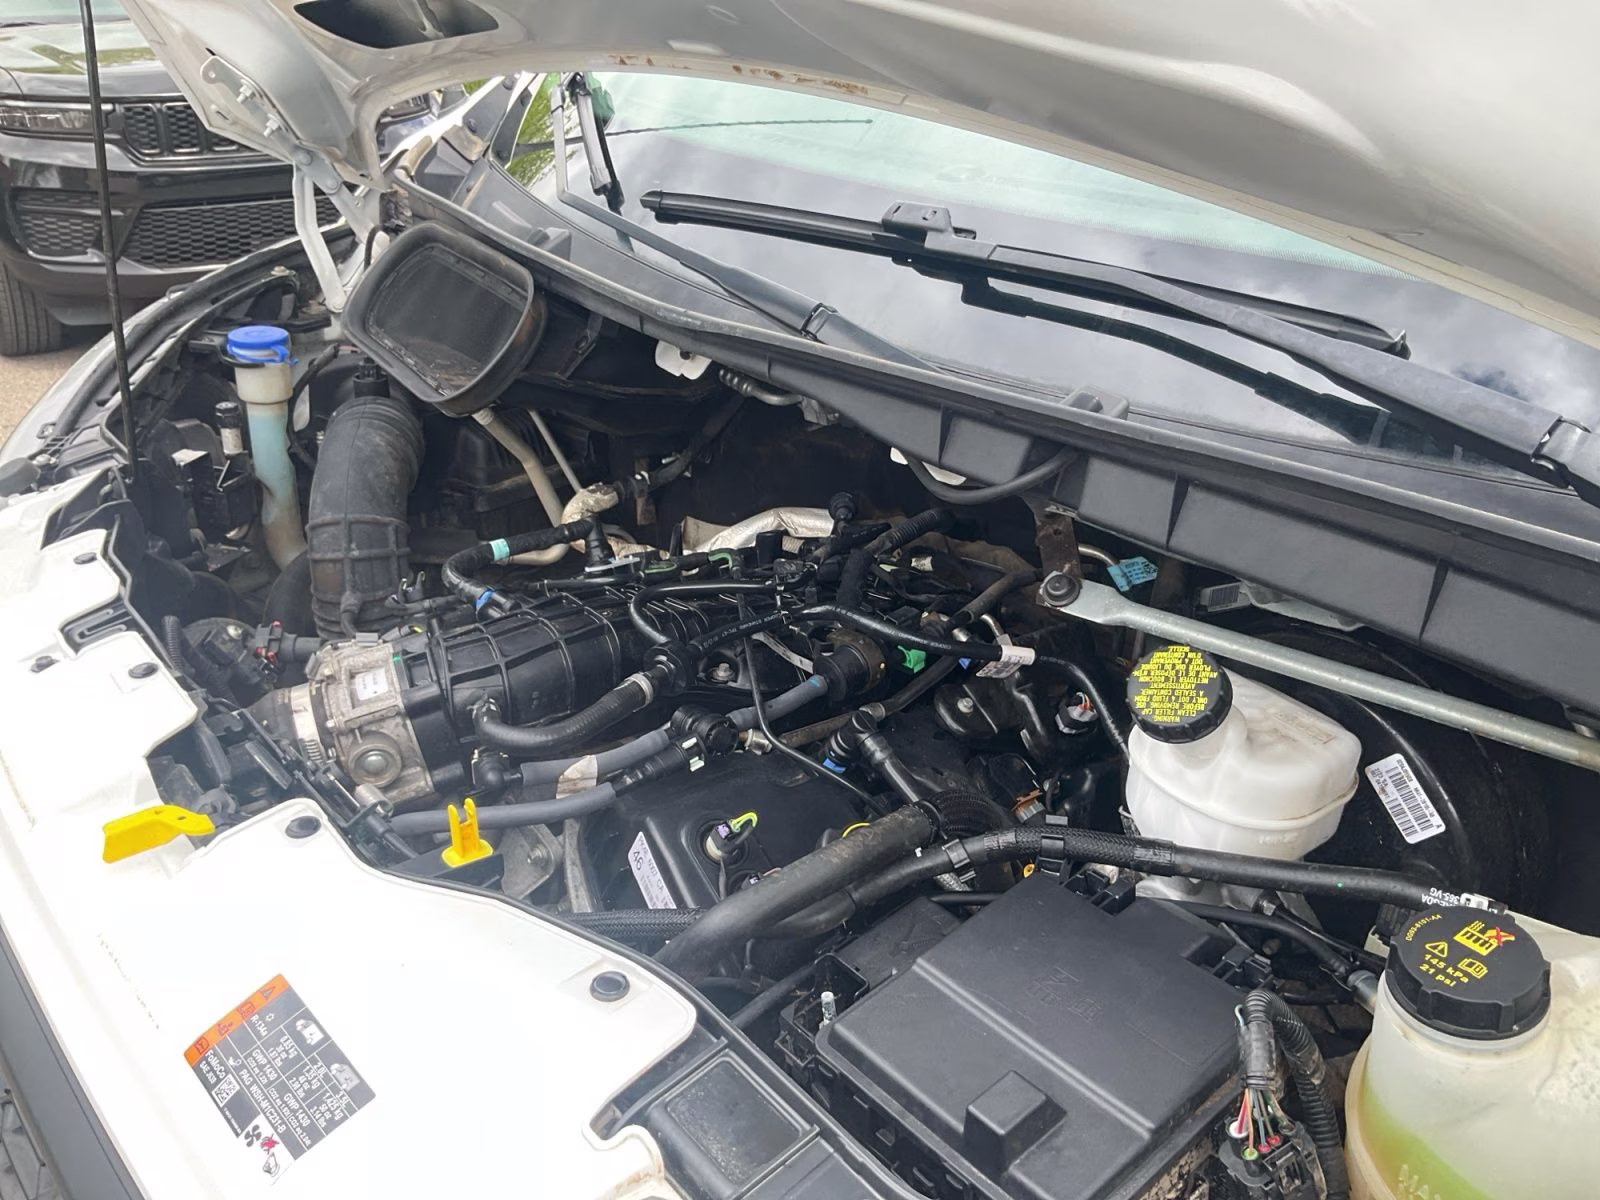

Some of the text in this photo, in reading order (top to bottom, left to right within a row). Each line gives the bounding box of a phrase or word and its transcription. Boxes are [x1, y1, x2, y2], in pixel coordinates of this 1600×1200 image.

[1182, 702, 1204, 710] BEFORE
[633, 851, 643, 870] 46
[1419, 963, 1457, 987] 21 psi
[1424, 954, 1469, 983] 145 kPa
[249, 1014, 269, 1037] R-134a
[251, 1048, 277, 1080] GWP 1430
[285, 1046, 298, 1059] kg
[198, 1060, 210, 1073] SAE
[203, 1050, 227, 1079] FoMoCo
[313, 1061, 327, 1078] 2.0L
[302, 1065, 322, 1089] 1.35 kg
[238, 1068, 287, 1133] PAG WSH-M1C231-B
[296, 1087, 306, 1098] lbs
[282, 1092, 310, 1126] GWP 1430
[322, 1092, 344, 1120] 1.425 kg
[317, 1116, 328, 1127] lbs
